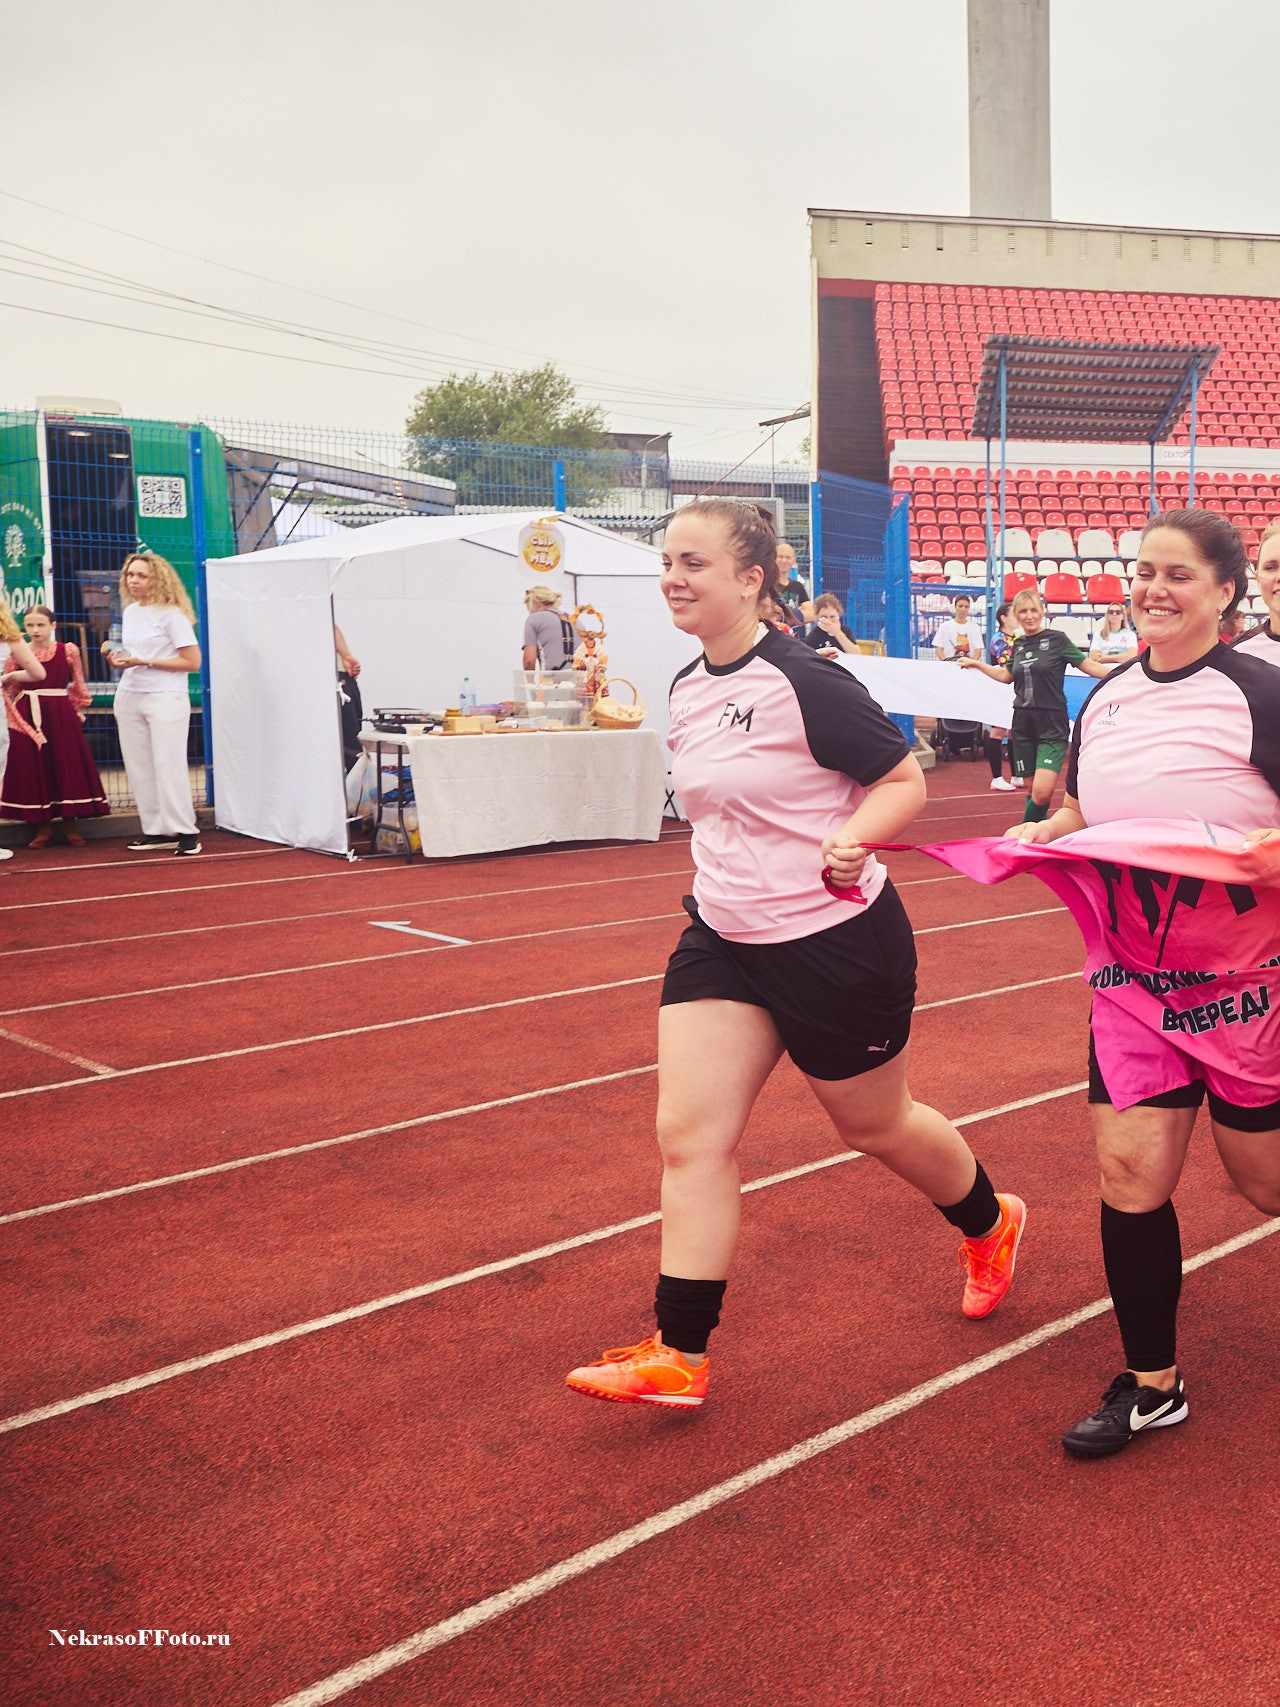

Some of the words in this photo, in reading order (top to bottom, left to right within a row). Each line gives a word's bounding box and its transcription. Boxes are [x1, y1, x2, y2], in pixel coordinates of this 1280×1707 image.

[531, 536, 554, 547] СЫР
[718, 702, 755, 732] FM
[1016, 760, 1025, 772] 11
[1161, 985, 1271, 1035] ВПЕРЕД!
